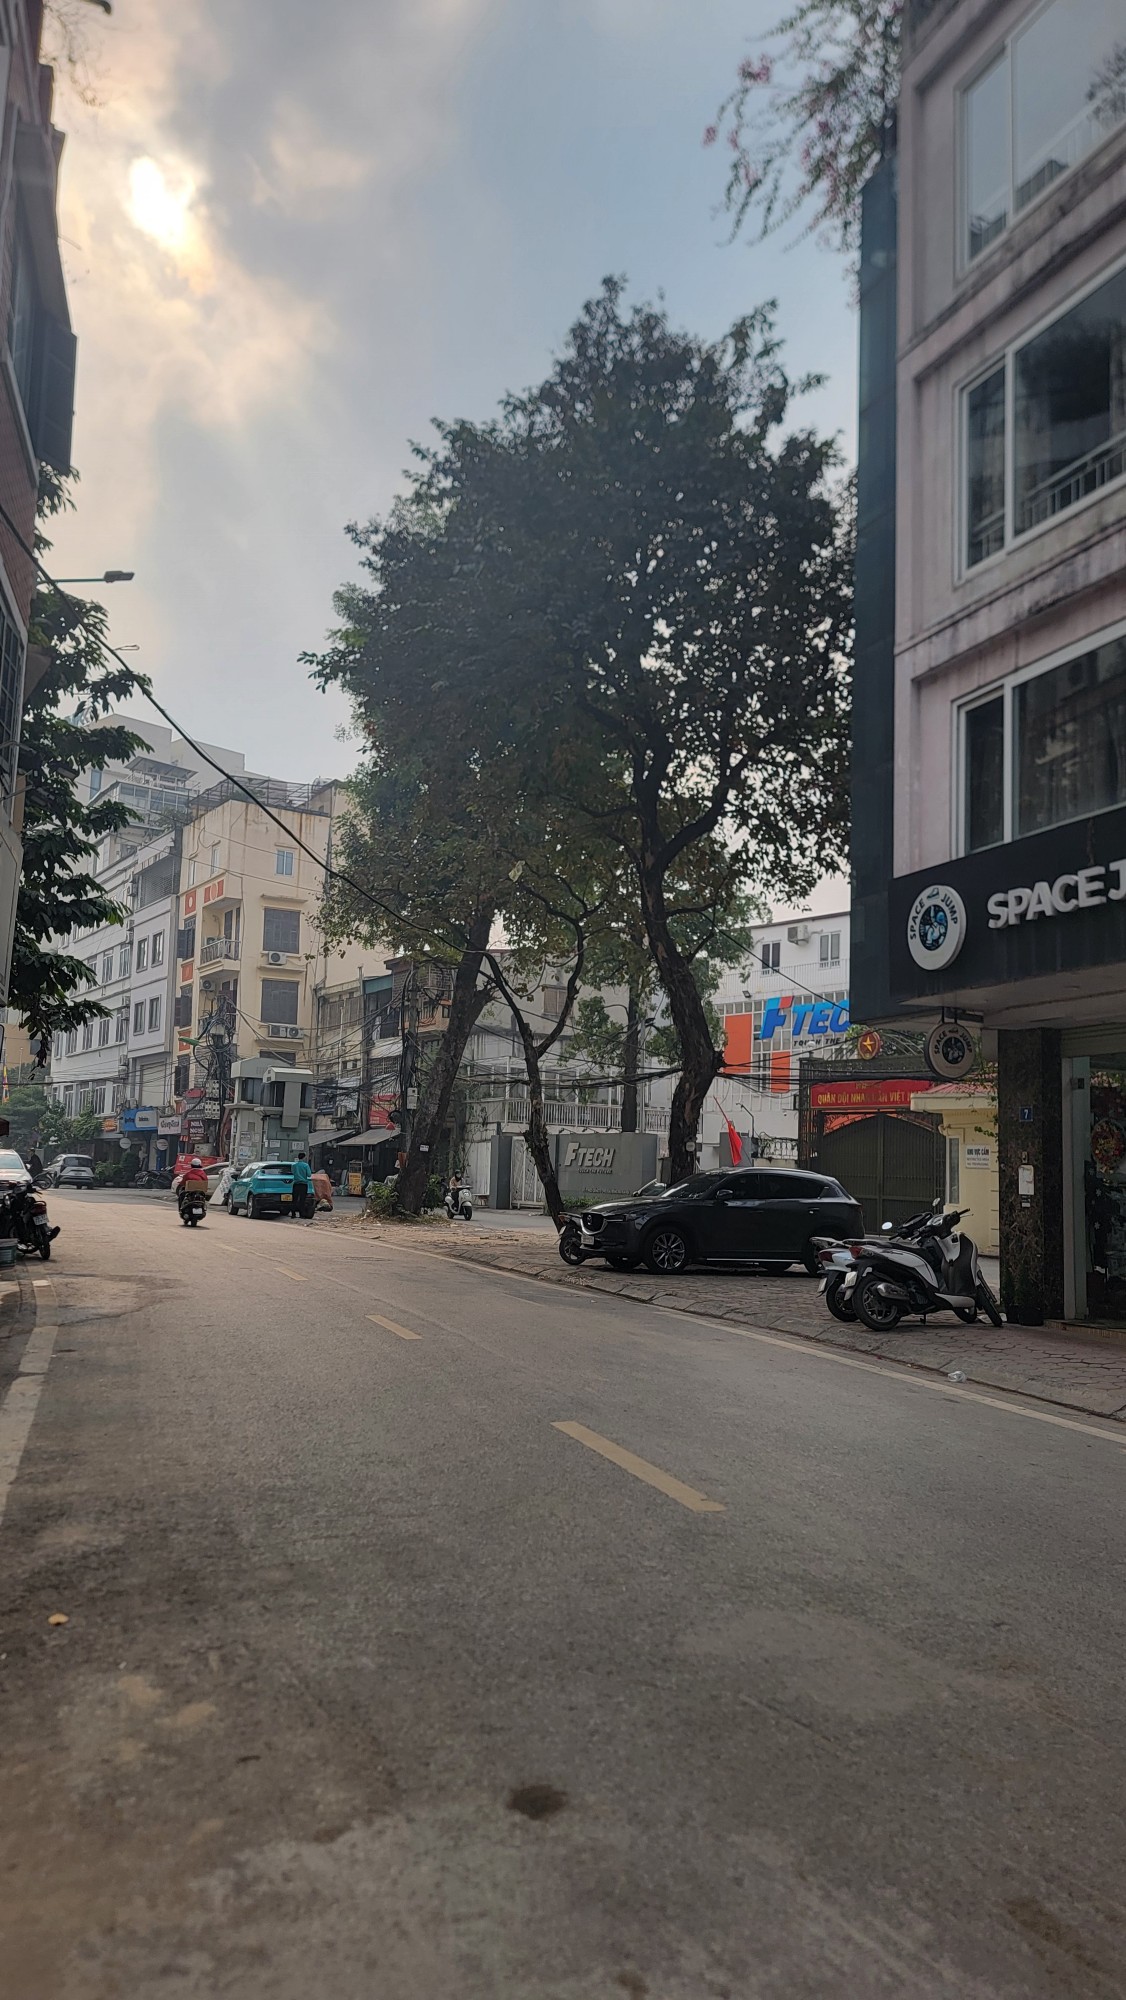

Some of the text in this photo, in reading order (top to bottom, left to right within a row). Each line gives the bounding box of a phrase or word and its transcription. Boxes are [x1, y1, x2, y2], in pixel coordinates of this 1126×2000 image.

[987, 866, 1107, 929] SPACE
[908, 893, 959, 940] SPACE JUMP
[934, 1030, 973, 1054] SPACE JUMP
[1023, 1108, 1029, 1119] 7
[564, 1142, 615, 1167] FTECH
